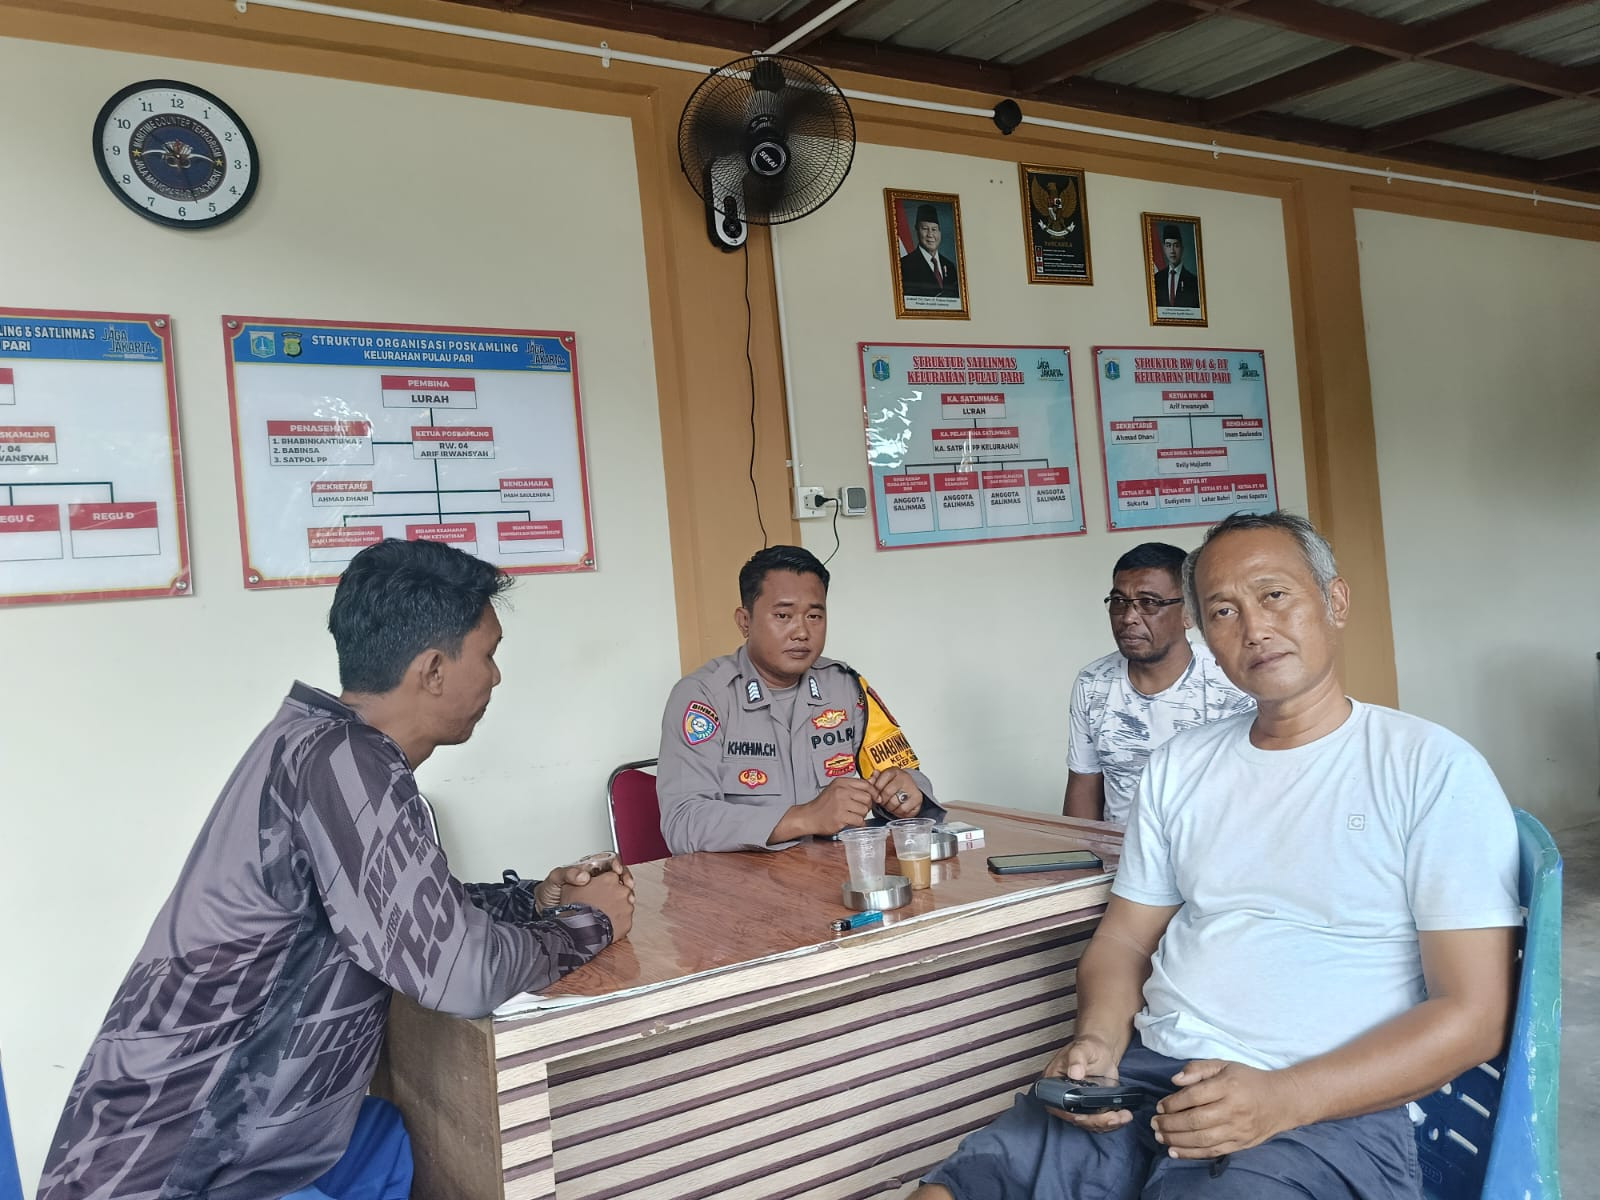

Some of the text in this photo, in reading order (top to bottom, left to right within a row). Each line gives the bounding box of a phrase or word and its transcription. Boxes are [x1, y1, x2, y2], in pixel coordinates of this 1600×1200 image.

[141, 102, 154, 113] 11
[171, 98, 184, 109] 12
[203, 110, 209, 119] 1
[117, 119, 131, 130] 10
[224, 131, 233, 142] 2
[112, 145, 121, 156] 9
[234, 159, 242, 170] 3
[758, 150, 778, 169] SEKAI
[122, 174, 131, 185] 8
[229, 185, 237, 195] 4
[147, 197, 155, 207] 7
[208, 202, 217, 212] 5
[178, 206, 187, 217] 6
[25, 325, 33, 338] &
[34, 327, 96, 339] SATLINMAS
[2, 340, 31, 351] PARI
[311, 335, 519, 353] STRUKTUR ORGANISASI POSKAMLING
[364, 350, 474, 363] KELURAHAN PULAU PARI
[912, 355, 1018, 371] STRUKTUR SATLINMAS
[1134, 357, 1179, 370] STRUKTUR
[1180, 358, 1194, 370] RW
[907, 371, 1025, 385] KELURAHAN PULAU PARI
[1134, 371, 1185, 384] KELURAHAN
[407, 379, 450, 388] PEMBINA
[411, 394, 450, 404] LURAH
[960, 394, 999, 403] SATLINMAS
[458, 442, 469, 450] 04
[981, 443, 1019, 451] KELURAHAN
[26, 514, 35, 523] C
[92, 511, 135, 521] REGU D
[811, 725, 856, 750] POLRI
